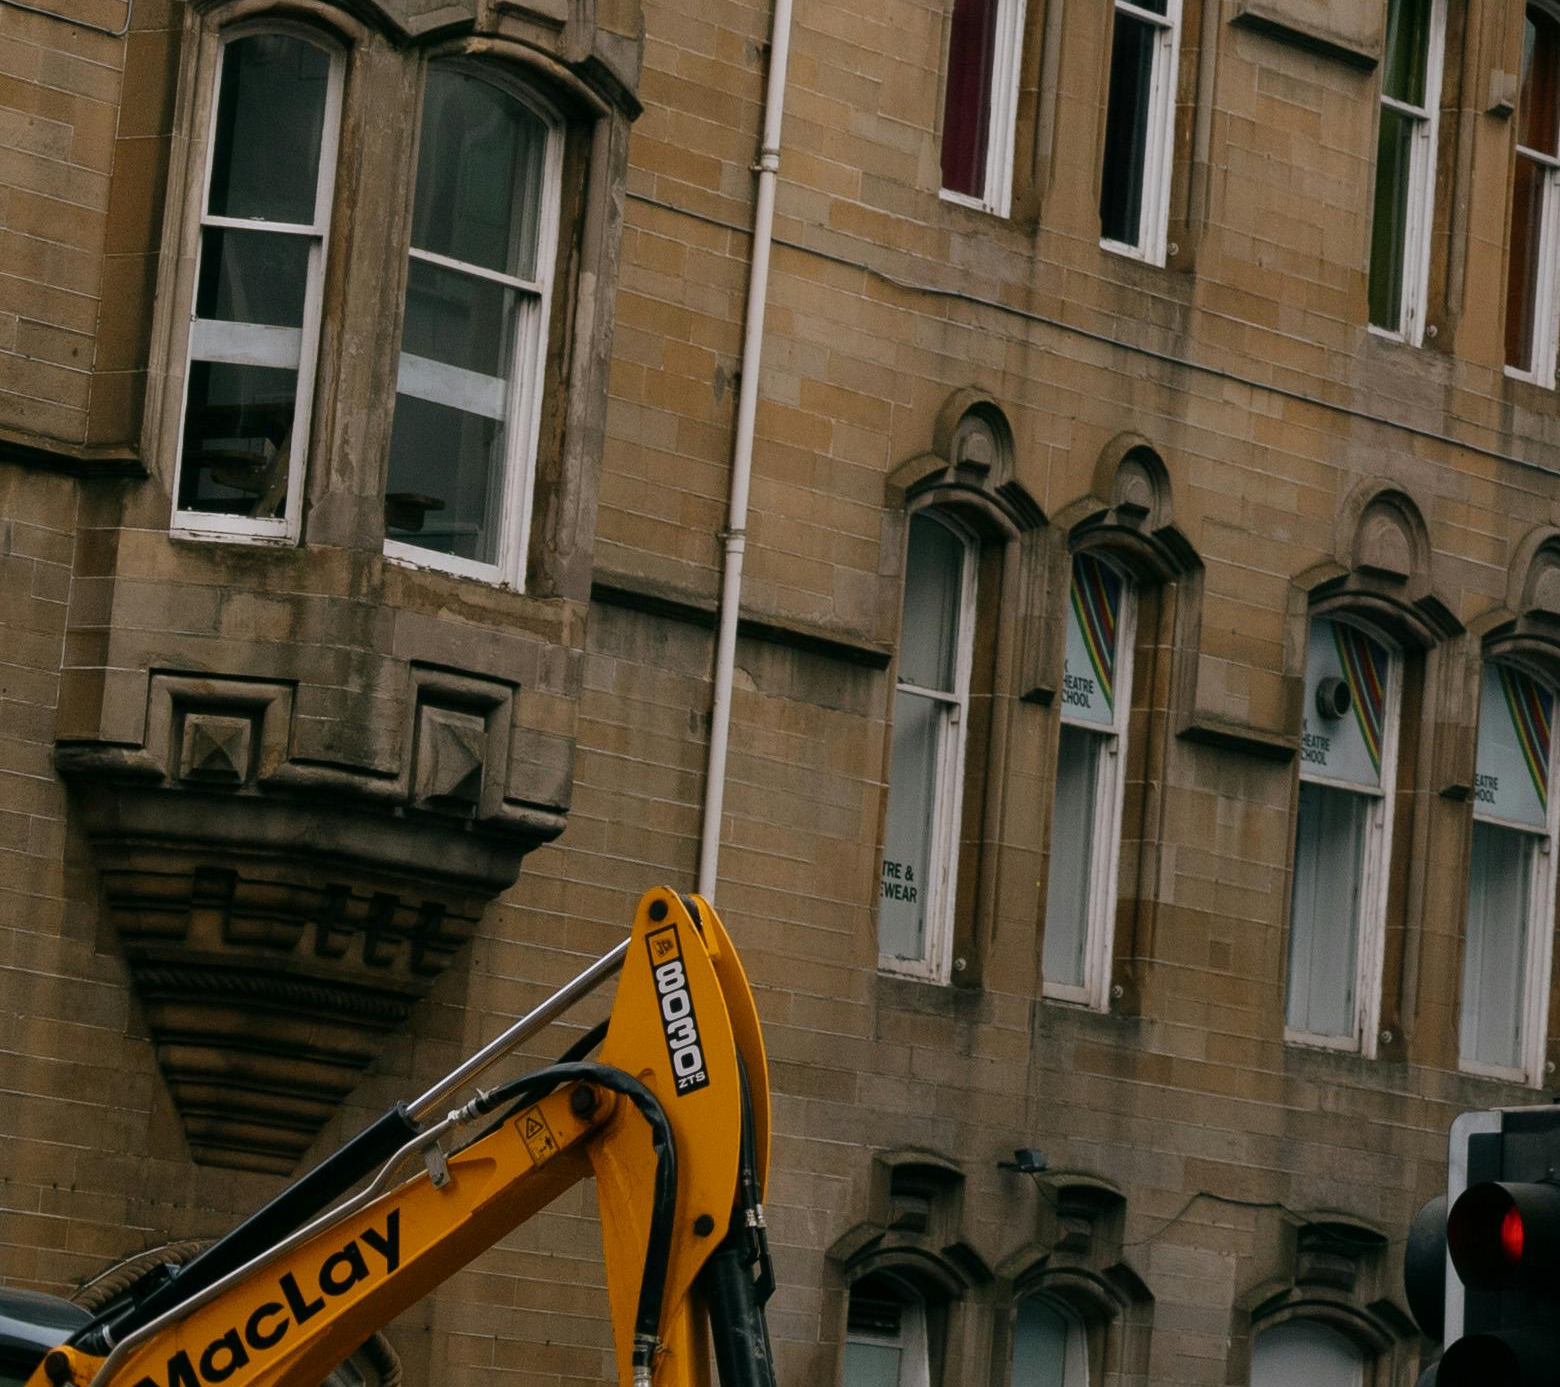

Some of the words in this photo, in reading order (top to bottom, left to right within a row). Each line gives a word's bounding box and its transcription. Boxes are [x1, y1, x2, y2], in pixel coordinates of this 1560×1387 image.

[904, 865, 914, 882] &
[655, 960, 703, 1077] 8030
[678, 1070, 706, 1090] ZTS
